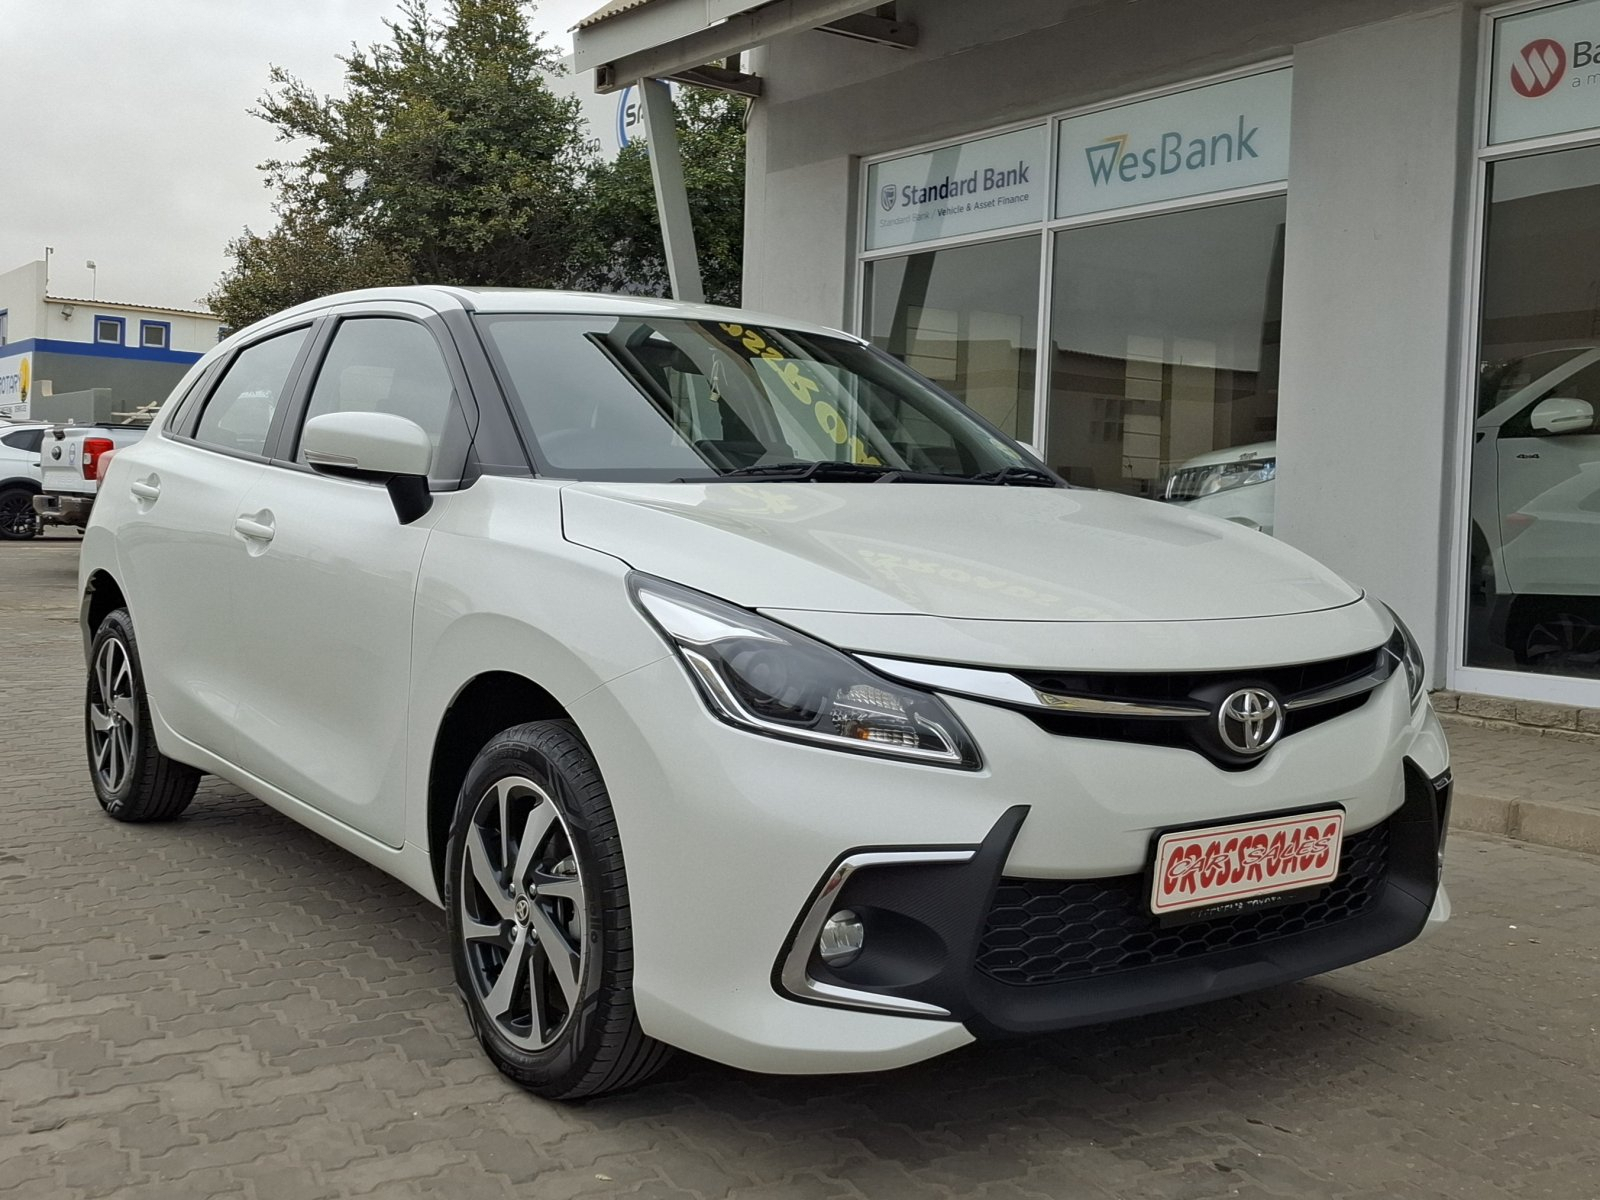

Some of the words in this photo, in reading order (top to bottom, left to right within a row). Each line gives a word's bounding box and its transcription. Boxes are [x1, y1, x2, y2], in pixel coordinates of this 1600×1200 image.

[1085, 115, 1259, 187] WesBank
[901, 170, 978, 207] Standard
[983, 160, 1030, 192] Bank
[937, 206, 964, 217] Vehicle
[966, 203, 972, 212] &
[973, 198, 996, 210] Asset
[997, 193, 1030, 206] Finance
[1163, 822, 1337, 895] CROSSROADS
[1169, 854, 1229, 878] CAR
[1243, 837, 1331, 865] SALES
